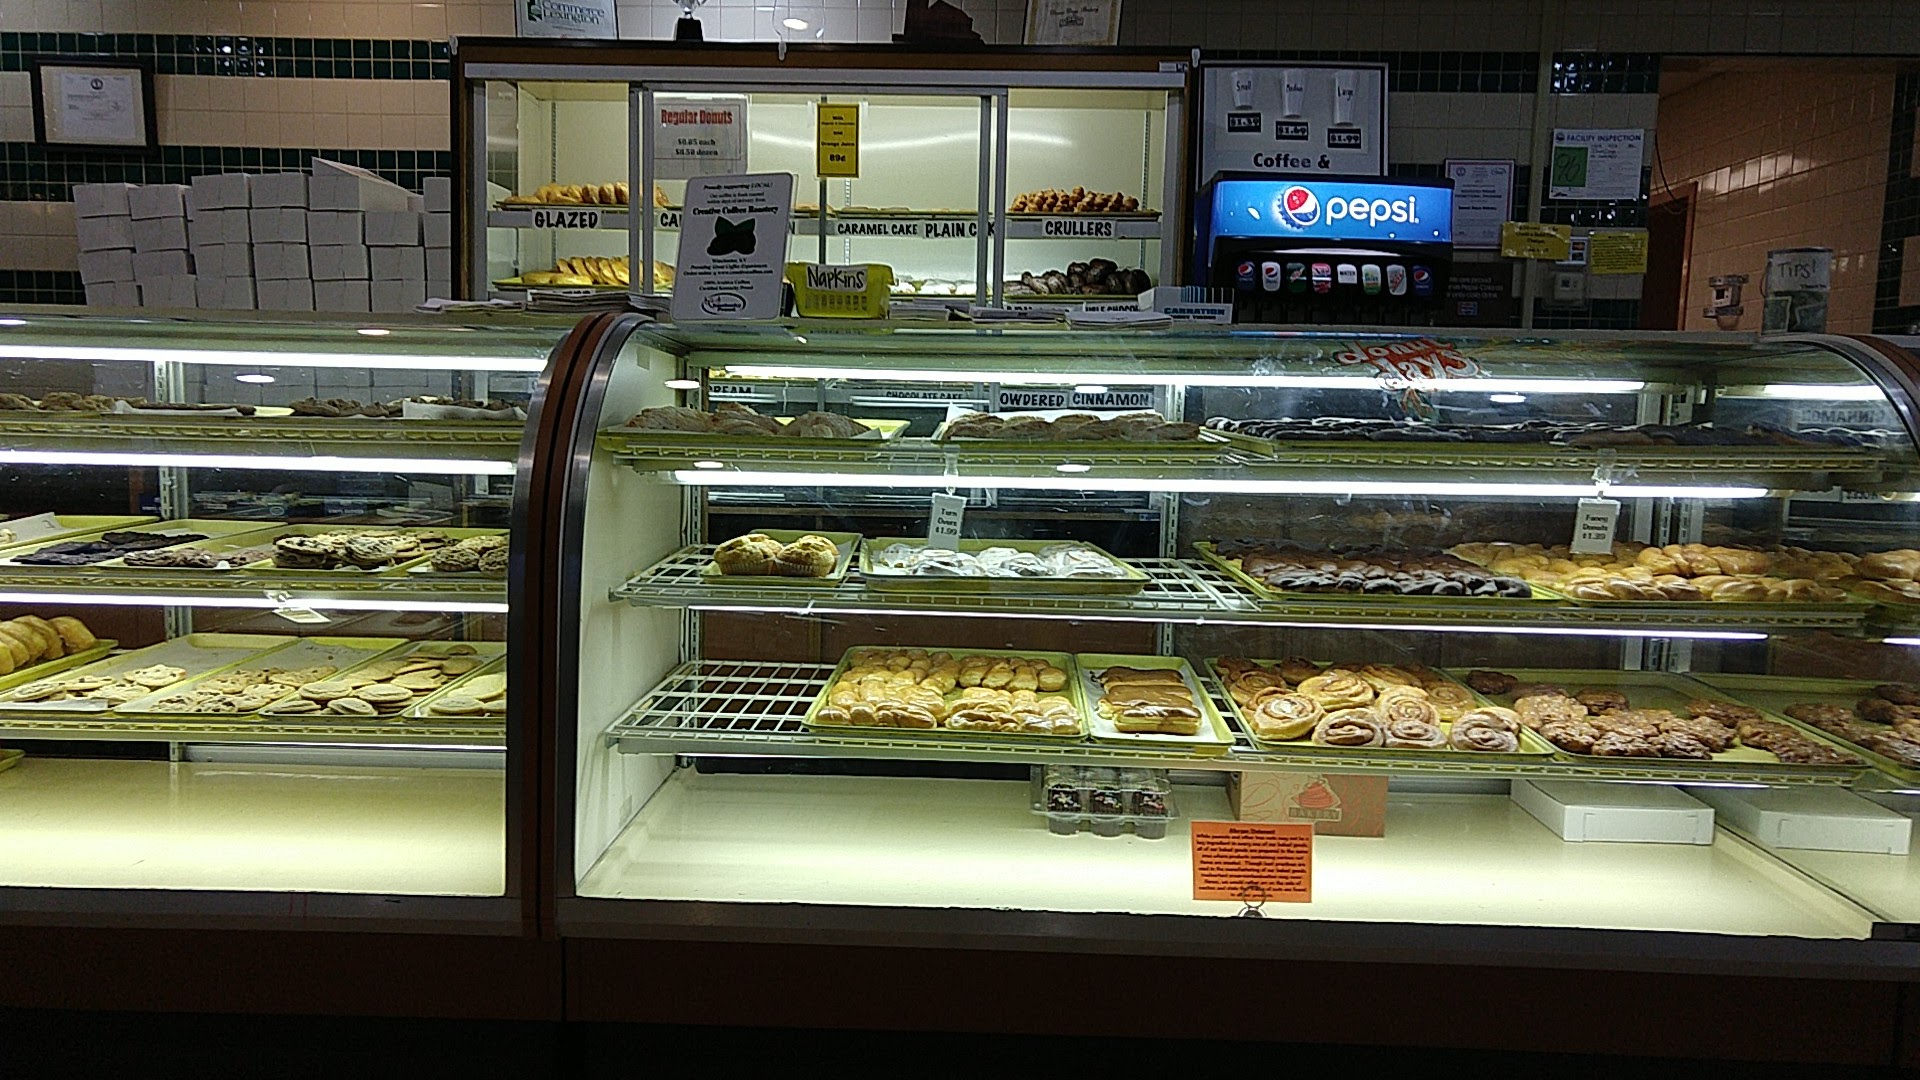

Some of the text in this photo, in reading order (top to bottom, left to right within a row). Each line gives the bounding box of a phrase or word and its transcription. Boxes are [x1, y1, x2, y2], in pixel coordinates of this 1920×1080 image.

[1337, 86, 1353, 101] Large
[661, 109, 732, 125] Regular Donuts
[697, 148, 718, 156] dozen
[1253, 153, 1331, 169] Coffee &
[692, 207, 721, 215] Creative
[748, 206, 779, 214] Roastery
[1325, 195, 1419, 228] pepsi
[534, 211, 598, 228] GLAZED
[837, 223, 918, 235] CARAMEL CAKE
[924, 222, 965, 237] PLAIN
[1045, 221, 1112, 236] CRULLERS
[807, 266, 865, 289] Napkins
[1164, 307, 1225, 316] CARNATION
[1000, 392, 1065, 407] OWDERED
[1072, 392, 1149, 406] CINNAMON
[941, 507, 957, 517] Turn
[1585, 514, 1609, 523] Fancy
[937, 517, 957, 527] Overs
[936, 526, 957, 536] $1.99
[1290, 809, 1338, 819] BAKERY
